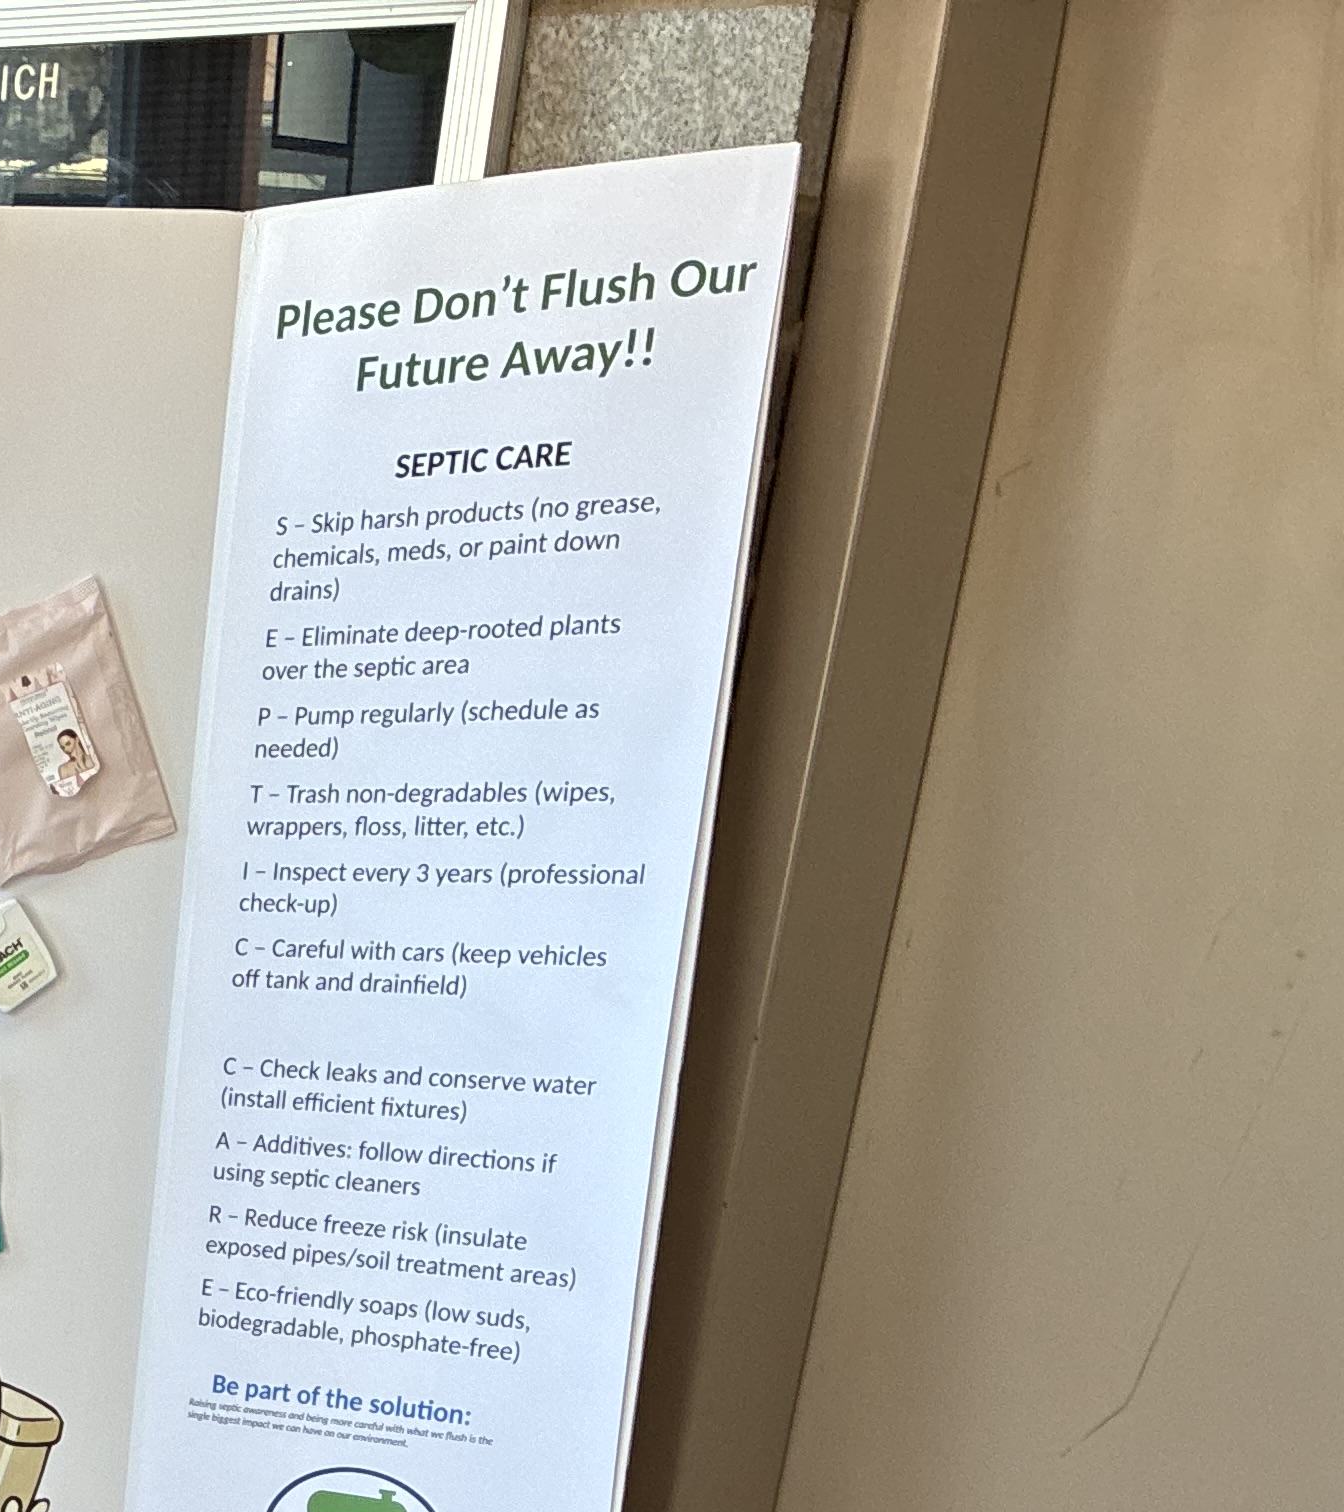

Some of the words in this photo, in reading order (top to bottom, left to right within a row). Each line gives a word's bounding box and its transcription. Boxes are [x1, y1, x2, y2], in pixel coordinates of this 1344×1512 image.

[275, 298, 401, 340] Please
[539, 260, 656, 311] Flush
[669, 258, 758, 298] Our
[355, 351, 490, 392] Future
[498, 325, 655, 379] Away!!
[393, 446, 489, 479] SEPTIC
[494, 439, 573, 471] CARE
[264, 627, 279, 648] E
[300, 623, 399, 647] Eliminate
[403, 614, 544, 646] deep-rooted
[548, 612, 621, 641] plants
[261, 663, 309, 681] over
[312, 656, 348, 679] the
[352, 653, 417, 682] septic
[420, 657, 470, 676] area
[249, 783, 264, 804] T
[285, 781, 340, 804] Trash
[345, 780, 528, 808] non-degradables
[534, 779, 615, 807] (wipes,
[245, 819, 348, 841] wrappers,
[353, 814, 407, 840] floss,
[413, 814, 469, 840] litter,
[474, 813, 525, 840] etc.)
[234, 936, 249, 957] C
[270, 937, 345, 960] Careful
[349, 939, 396, 961] with
[401, 945, 445, 963] cars
[450, 940, 512, 969] (keep
[516, 943, 608, 967] vehicles
[230, 967, 262, 989] off
[264, 968, 310, 991] tank
[314, 970, 354, 992] and
[358, 971, 467, 1000] drainfield)
[213, 1130, 231, 1150] A
[251, 1132, 352, 1160] Additives:
[357, 1139, 424, 1164] follow
[427, 1143, 535, 1173] directions
[540, 1151, 559, 1174] if
[212, 1161, 266, 1188] using
[268, 1167, 330, 1191] septic
[334, 1169, 421, 1196] cleaners
